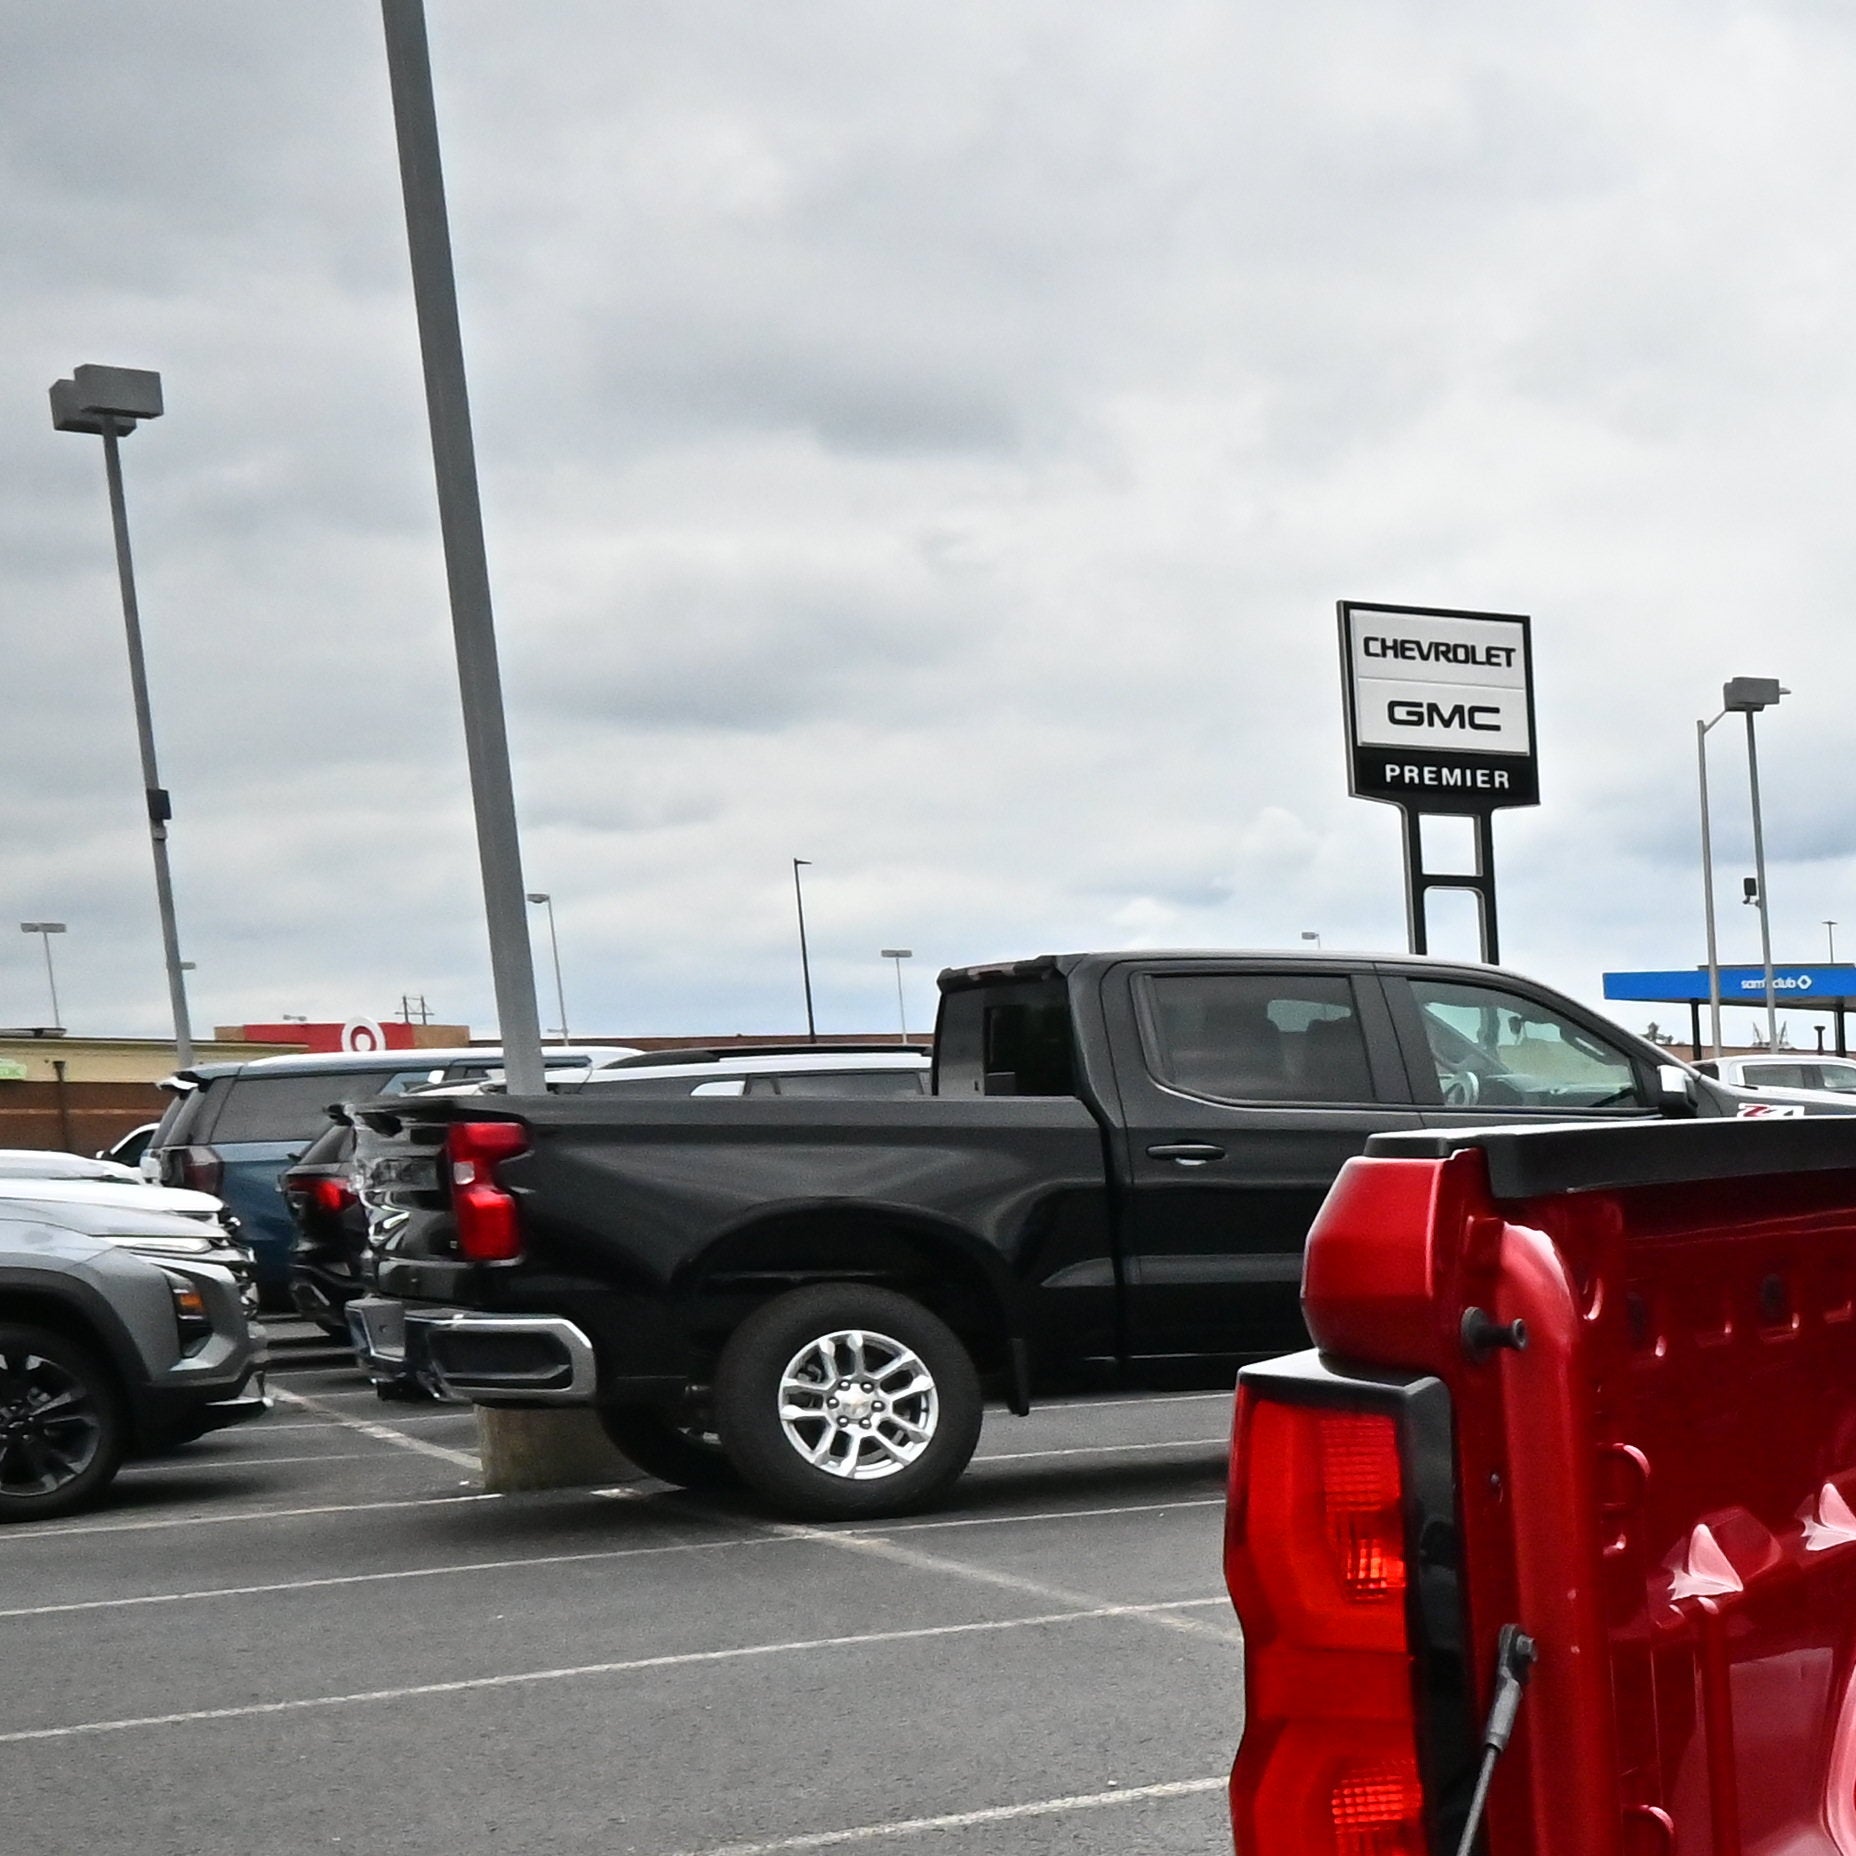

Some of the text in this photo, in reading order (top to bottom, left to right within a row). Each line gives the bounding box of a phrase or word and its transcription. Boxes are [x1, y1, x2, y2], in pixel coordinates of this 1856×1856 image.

[1363, 636, 1517, 668] CHEVROLET
[1387, 700, 1502, 732] GMC
[1384, 763, 1511, 790] PREMIER
